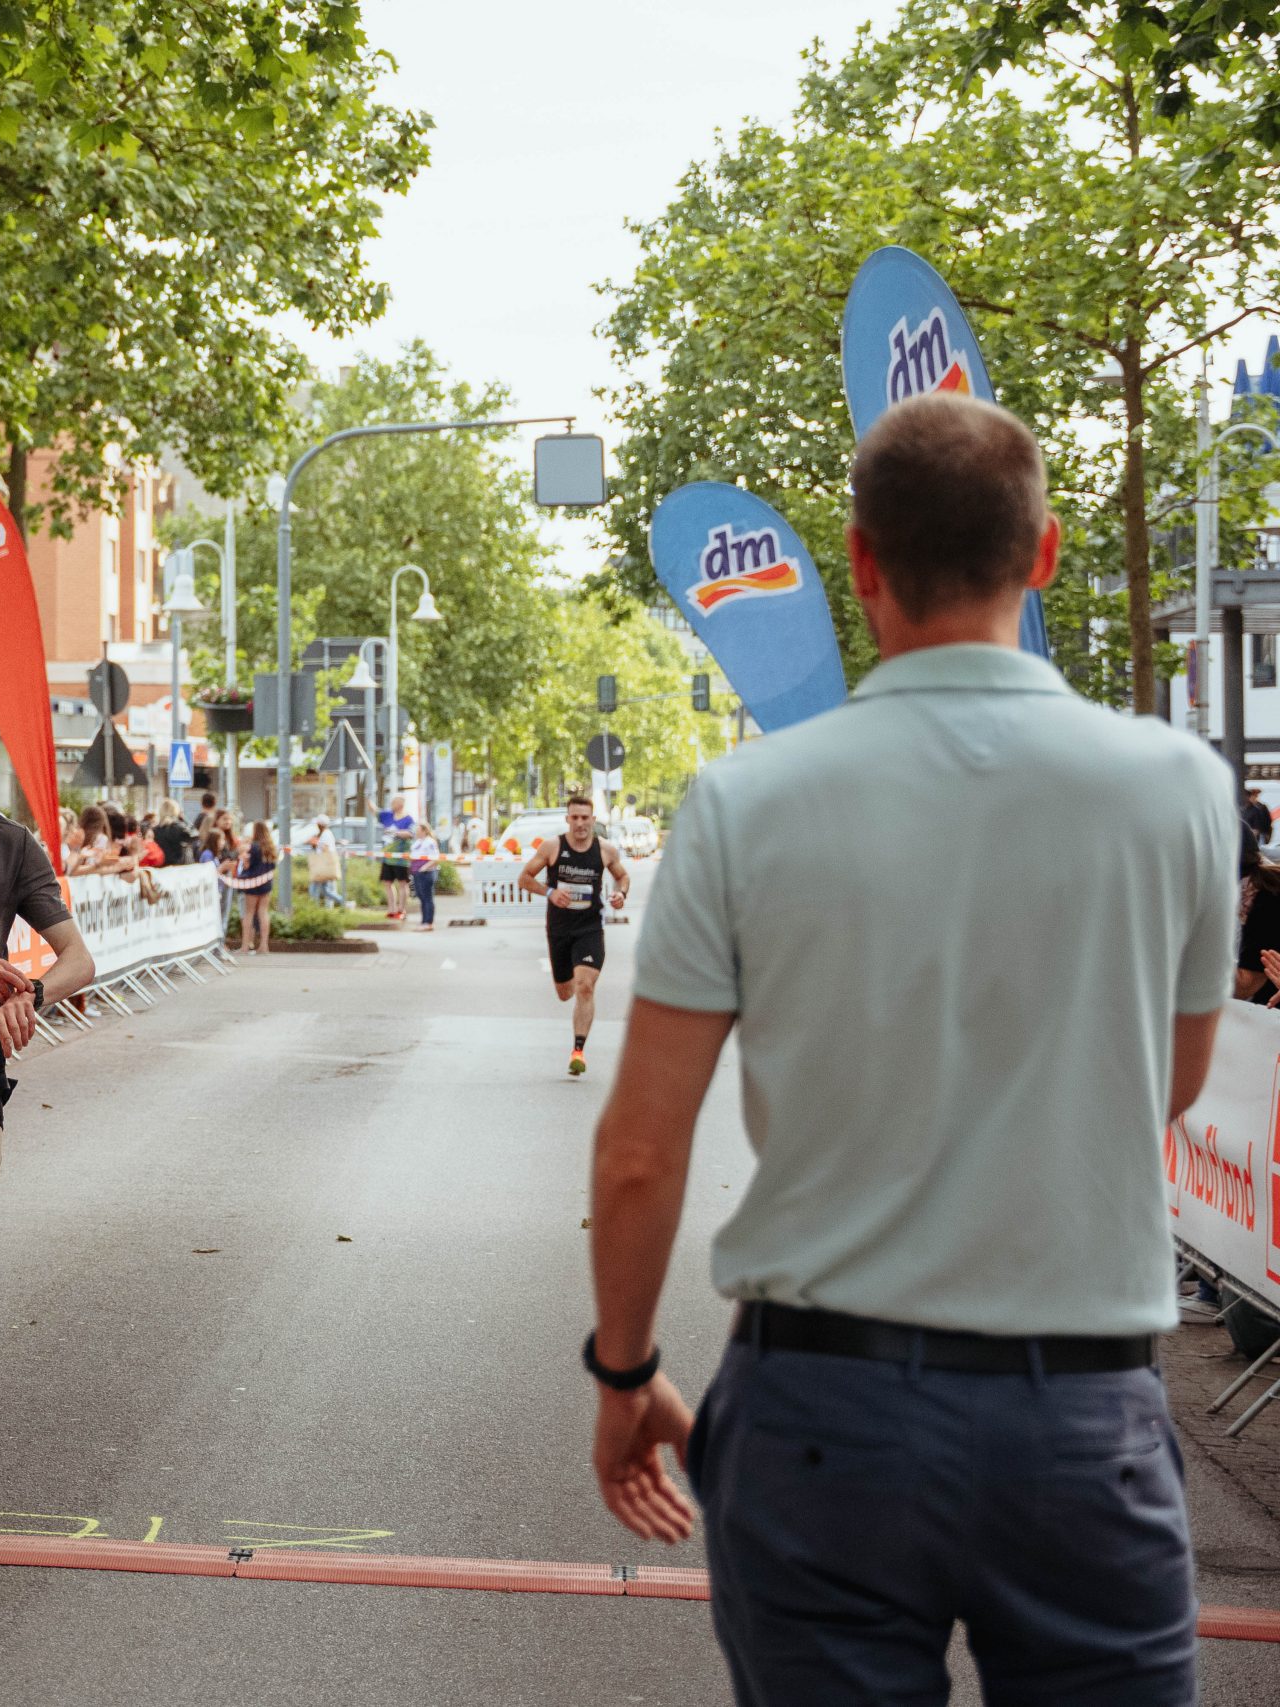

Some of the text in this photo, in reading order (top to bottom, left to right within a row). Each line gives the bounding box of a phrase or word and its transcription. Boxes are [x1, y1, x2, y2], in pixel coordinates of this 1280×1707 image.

[891, 315, 948, 402] dm
[705, 531, 777, 581] dm
[1180, 1114, 1255, 1233] Kaufland
